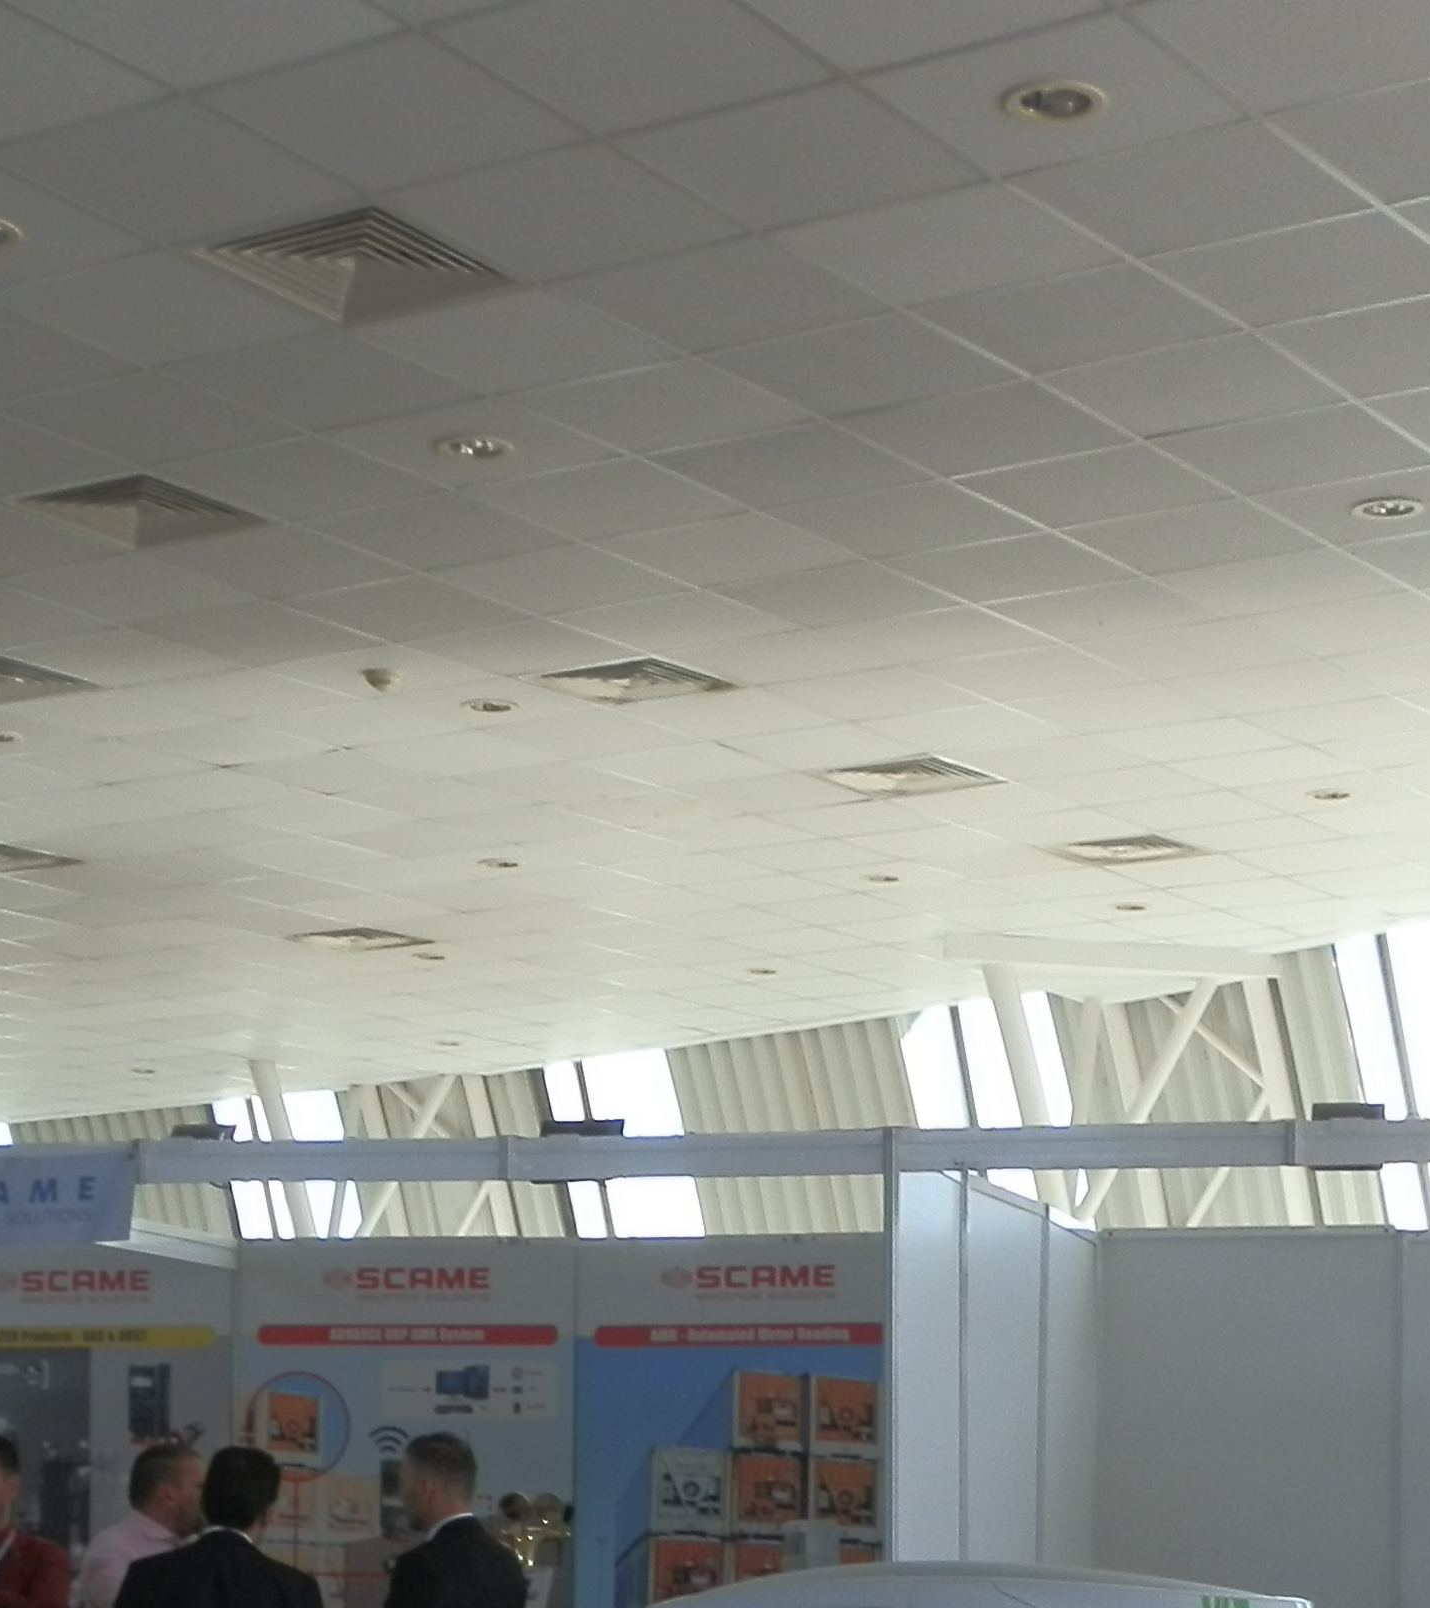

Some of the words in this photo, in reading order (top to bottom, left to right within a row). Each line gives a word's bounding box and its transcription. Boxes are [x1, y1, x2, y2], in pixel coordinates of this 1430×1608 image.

[5, 1208, 93, 1226] SOLUTIONS
[20, 1270, 150, 1292] SCAME
[355, 1267, 490, 1290] SCAME
[694, 1264, 836, 1289] SCAME
[687, 1326, 756, 1342] Automated
